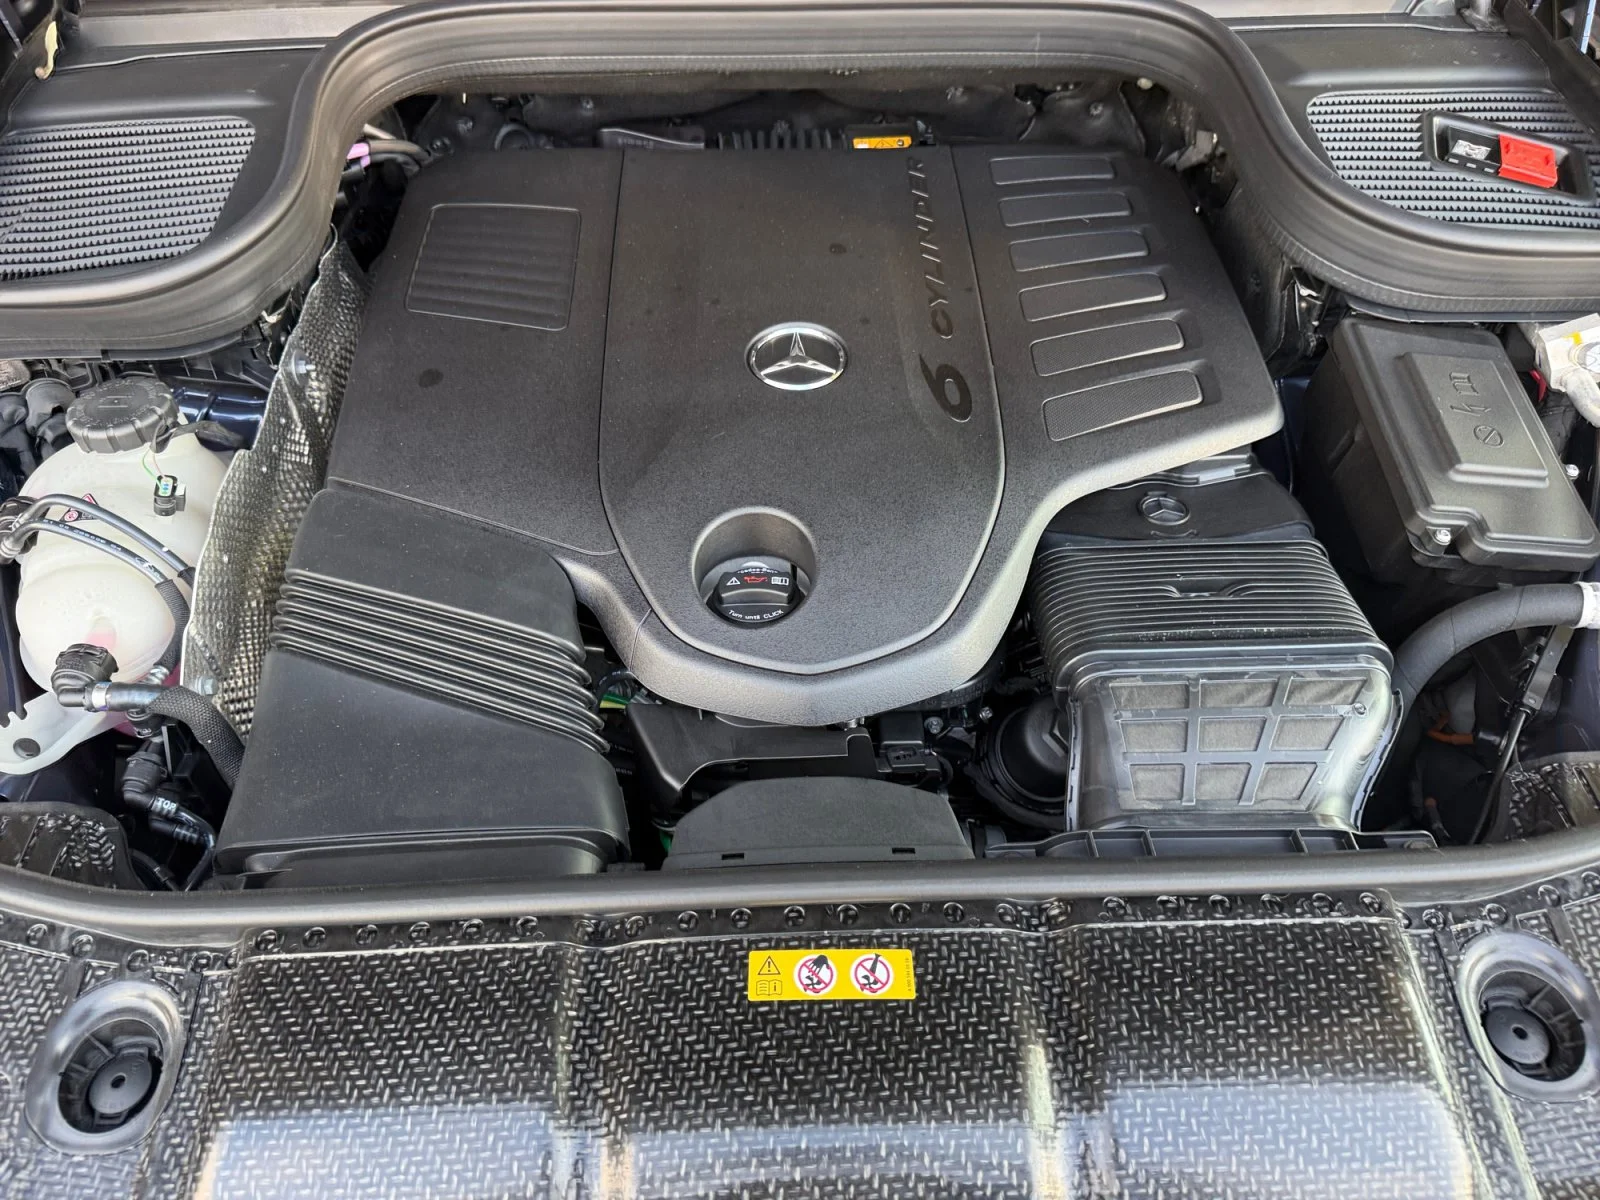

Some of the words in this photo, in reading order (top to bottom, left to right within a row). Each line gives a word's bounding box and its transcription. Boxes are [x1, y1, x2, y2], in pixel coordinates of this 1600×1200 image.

[907, 156, 953, 339] CYLINDER
[918, 352, 973, 423] 6
[728, 609, 743, 619] Turn
[763, 608, 784, 619] CLICK
[157, 796, 177, 811] TOP
